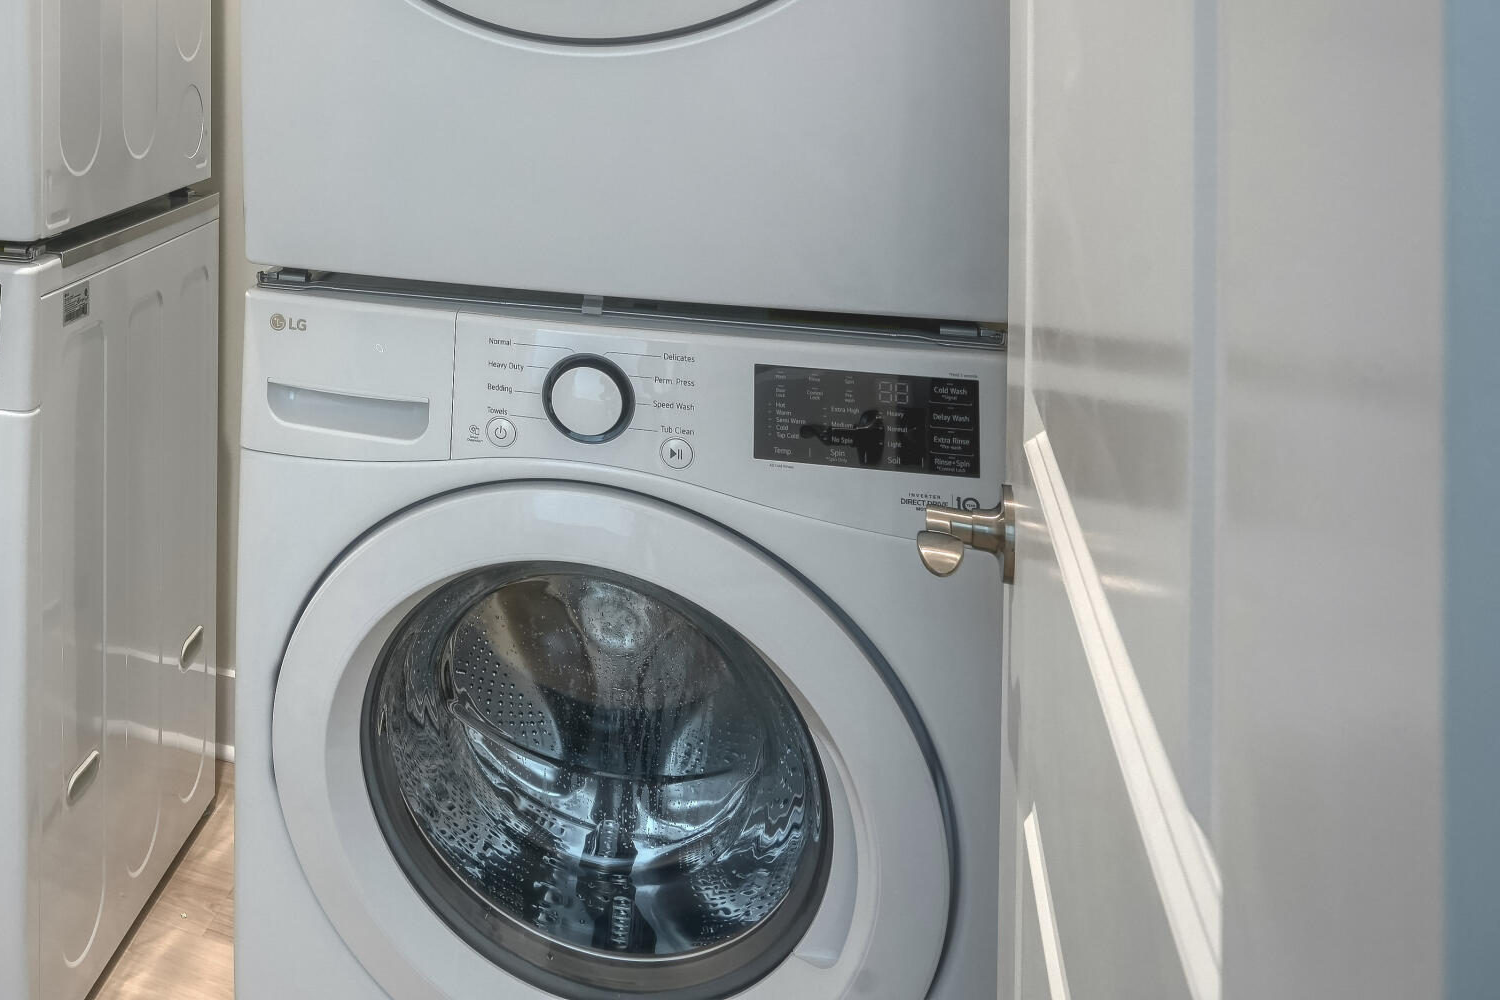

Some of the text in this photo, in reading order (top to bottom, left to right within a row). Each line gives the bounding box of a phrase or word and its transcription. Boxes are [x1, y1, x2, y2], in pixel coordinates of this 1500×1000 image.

[289, 317, 307, 331] LG
[488, 337, 512, 346] Normal
[663, 352, 695, 363] Delicates
[488, 360, 524, 372] Heavy Duty
[676, 378, 695, 387] Press
[487, 382, 513, 394] Bedding
[933, 386, 968, 395] Cold Wash
[653, 400, 695, 411] Speed Wash
[831, 405, 860, 416] Extra High
[487, 406, 508, 416] Towels
[887, 409, 904, 419] Heavy
[791, 417, 806, 425] Warm
[932, 412, 970, 423] Delay Wash
[831, 420, 854, 429] Medium
[887, 424, 908, 433] Normal
[661, 425, 695, 436] Tub Clean
[787, 432, 800, 440] Cold
[832, 435, 853, 445] No Spin
[933, 435, 970, 445] Extra Rinse
[887, 440, 902, 449] Light
[830, 448, 846, 458] Spin
[887, 456, 901, 465] Soil
[908, 492, 941, 500] INVERTER
[901, 497, 925, 507] DIRECT
